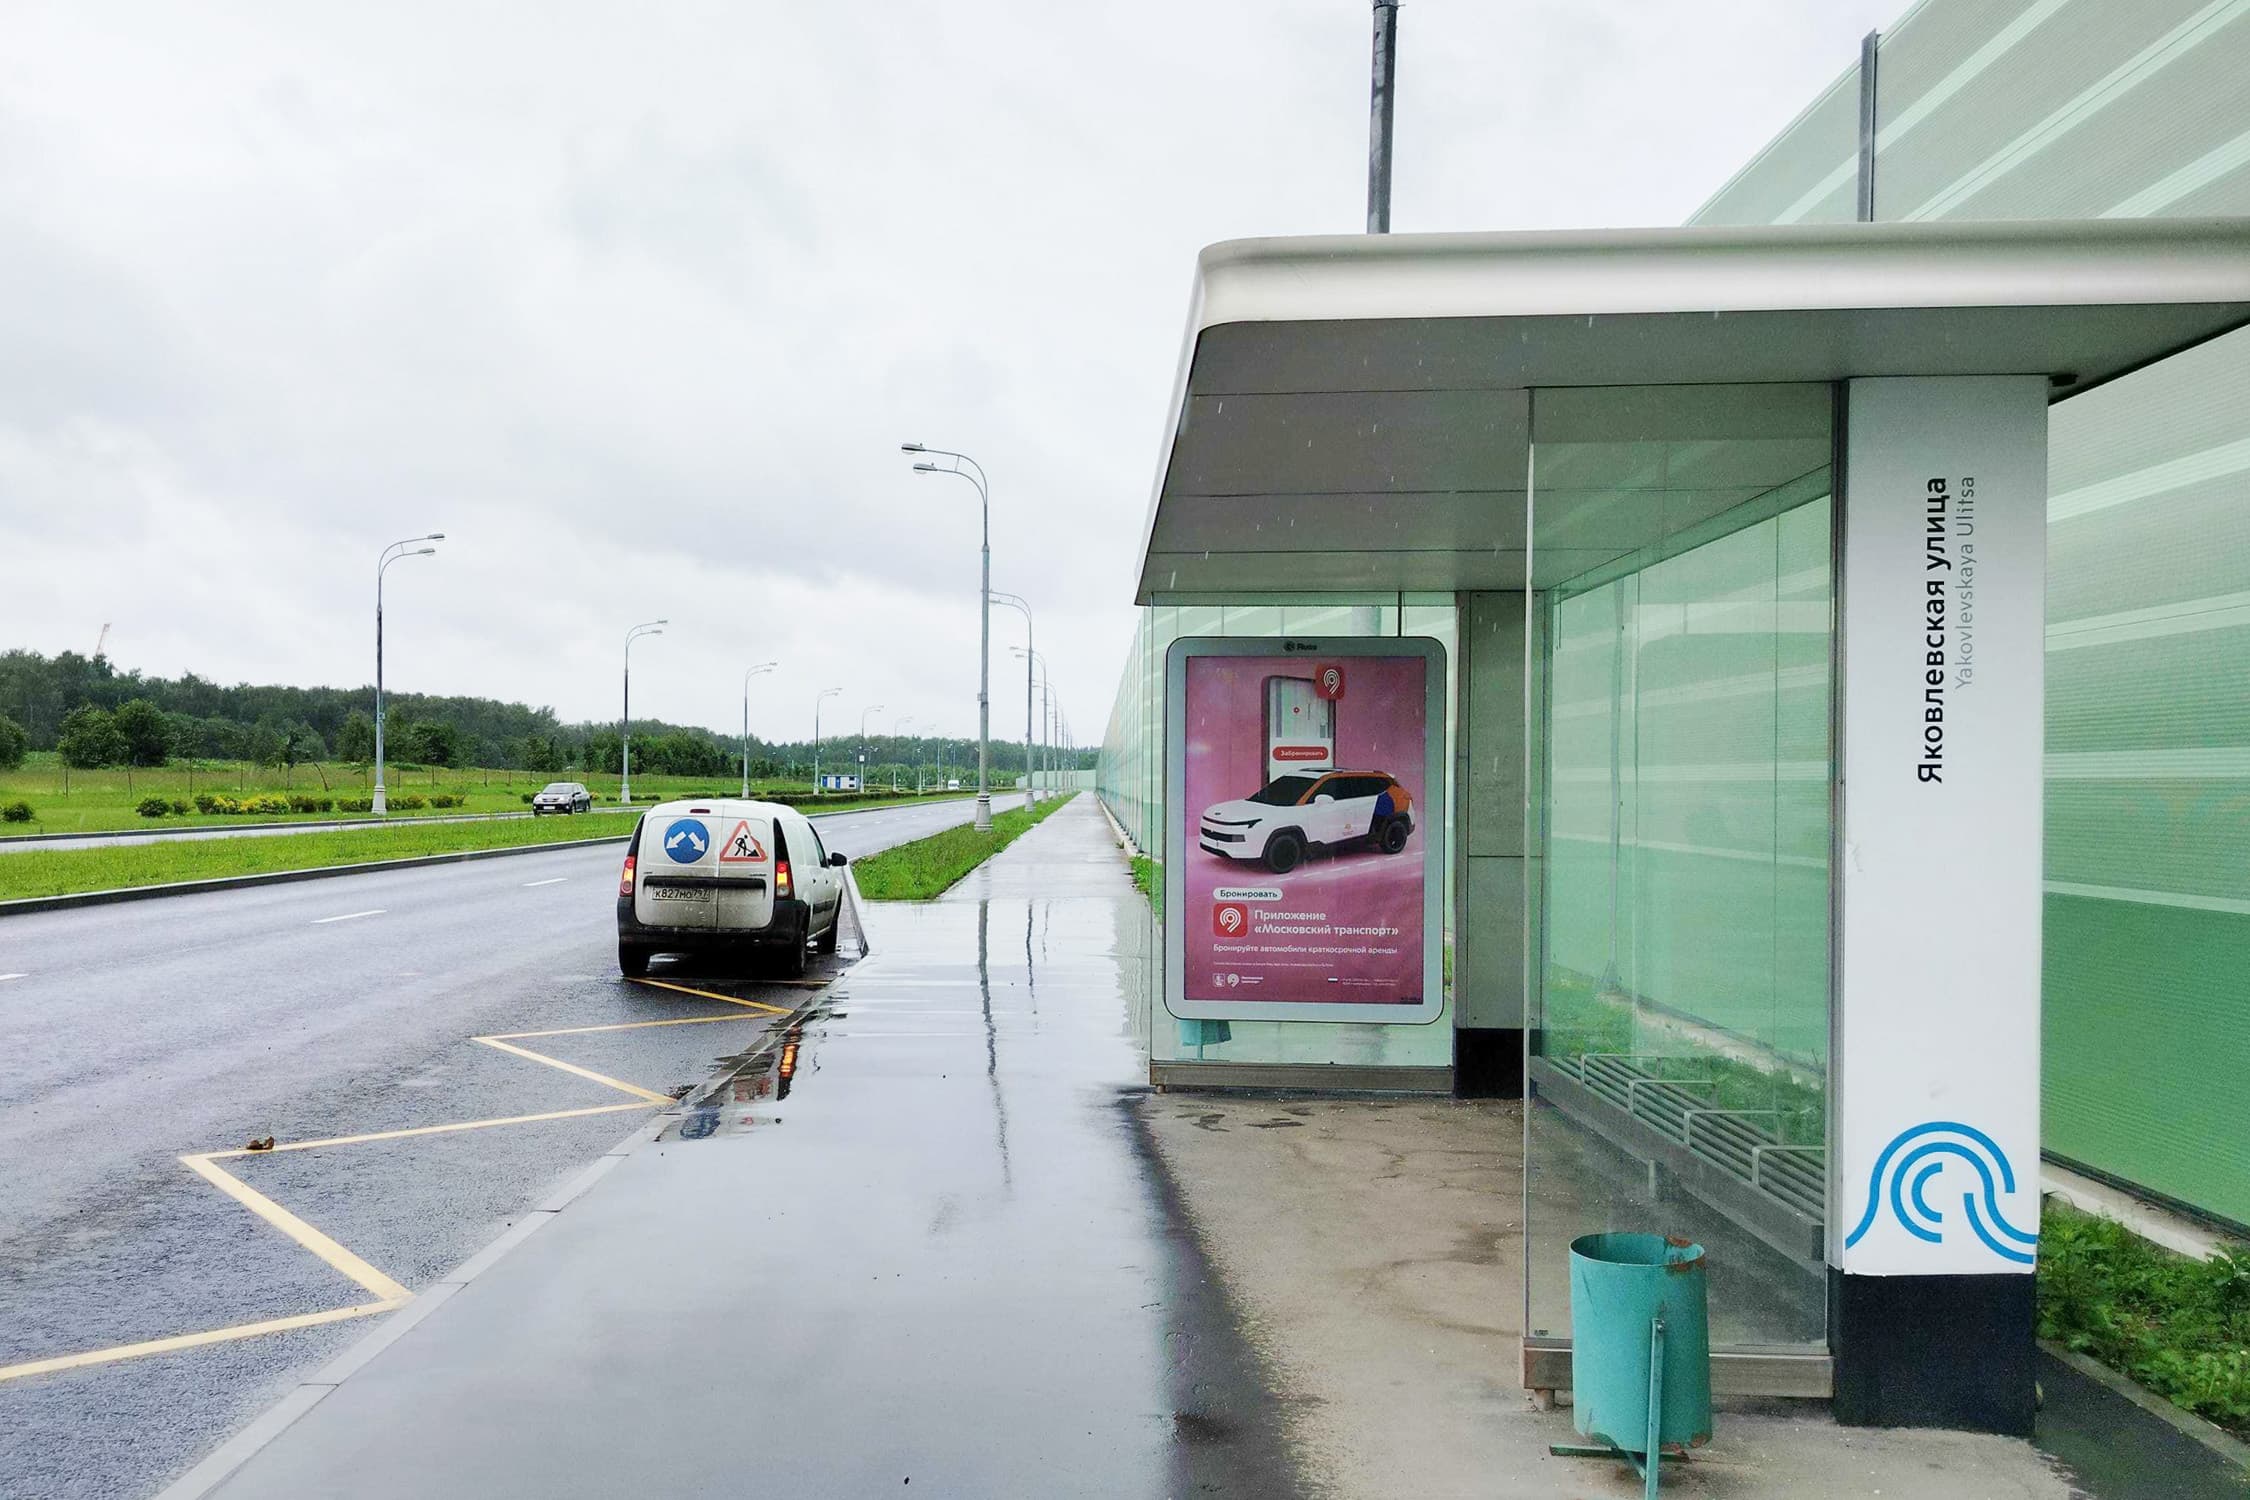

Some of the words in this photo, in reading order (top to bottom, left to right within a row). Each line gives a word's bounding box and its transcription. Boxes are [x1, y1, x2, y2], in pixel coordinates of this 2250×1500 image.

[1927, 477, 1951, 571] улица
[1955, 476, 1975, 537] Ulitsa
[1954, 543, 1977, 690] Yakovlevskaya
[1917, 580, 1945, 784] Яковлевская
[1220, 889, 1278, 899] Бронировать
[1254, 909, 1327, 922] Приложение
[1254, 923, 1331, 936] «Московский
[1333, 926, 1399, 937] транспорт»
[1213, 943, 1259, 954] Бронируйте
[1259, 944, 1307, 953] автомобили
[1308, 946, 1367, 955] краткосрочной
[1367, 947, 1398, 955] аренды
